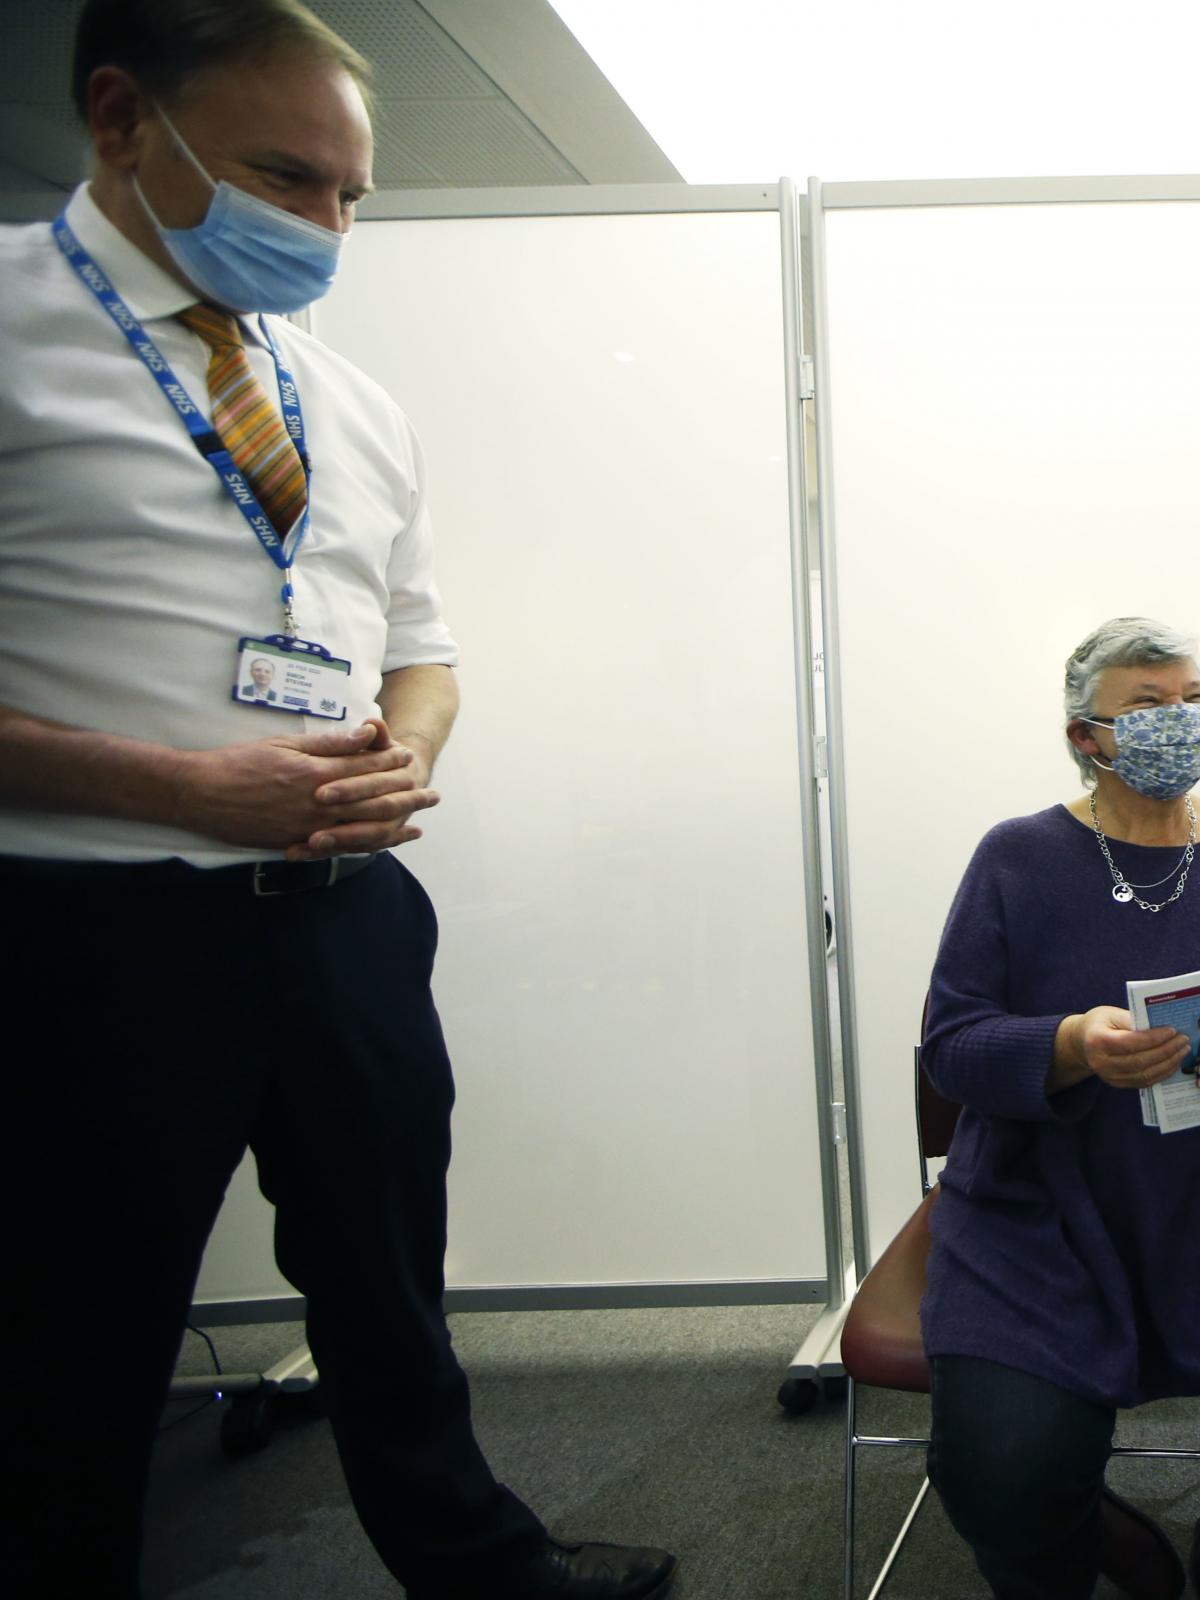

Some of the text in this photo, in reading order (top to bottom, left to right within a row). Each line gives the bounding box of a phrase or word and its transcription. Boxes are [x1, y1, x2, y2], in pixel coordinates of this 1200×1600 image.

[79, 264, 111, 293] NHS
[107, 301, 141, 331] NHS
[135, 341, 169, 373] NHS
[164, 383, 197, 415] NHS
[281, 380, 299, 407] NHS
[286, 415, 303, 439] NHS
[224, 473, 279, 548] NHS NHS
